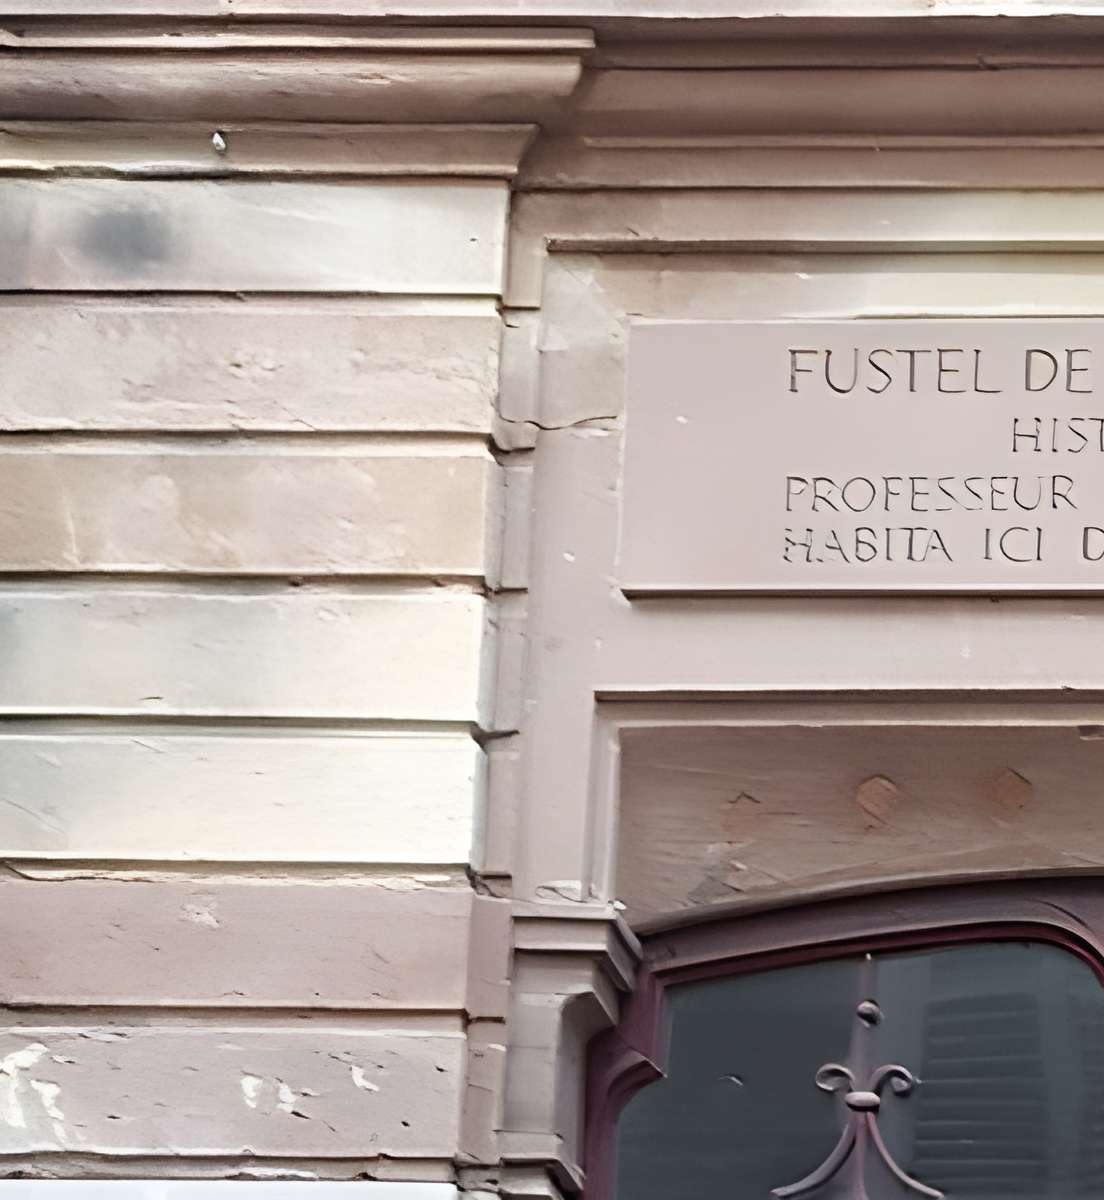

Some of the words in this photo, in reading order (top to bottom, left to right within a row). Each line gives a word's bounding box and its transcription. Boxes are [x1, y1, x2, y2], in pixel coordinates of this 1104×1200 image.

[787, 348, 1004, 394] FUSTEL
[1024, 348, 1094, 393] DE
[785, 474, 1079, 512] PROFESSEUR
[782, 526, 954, 564] HABITA
[983, 526, 1043, 563] ICI
